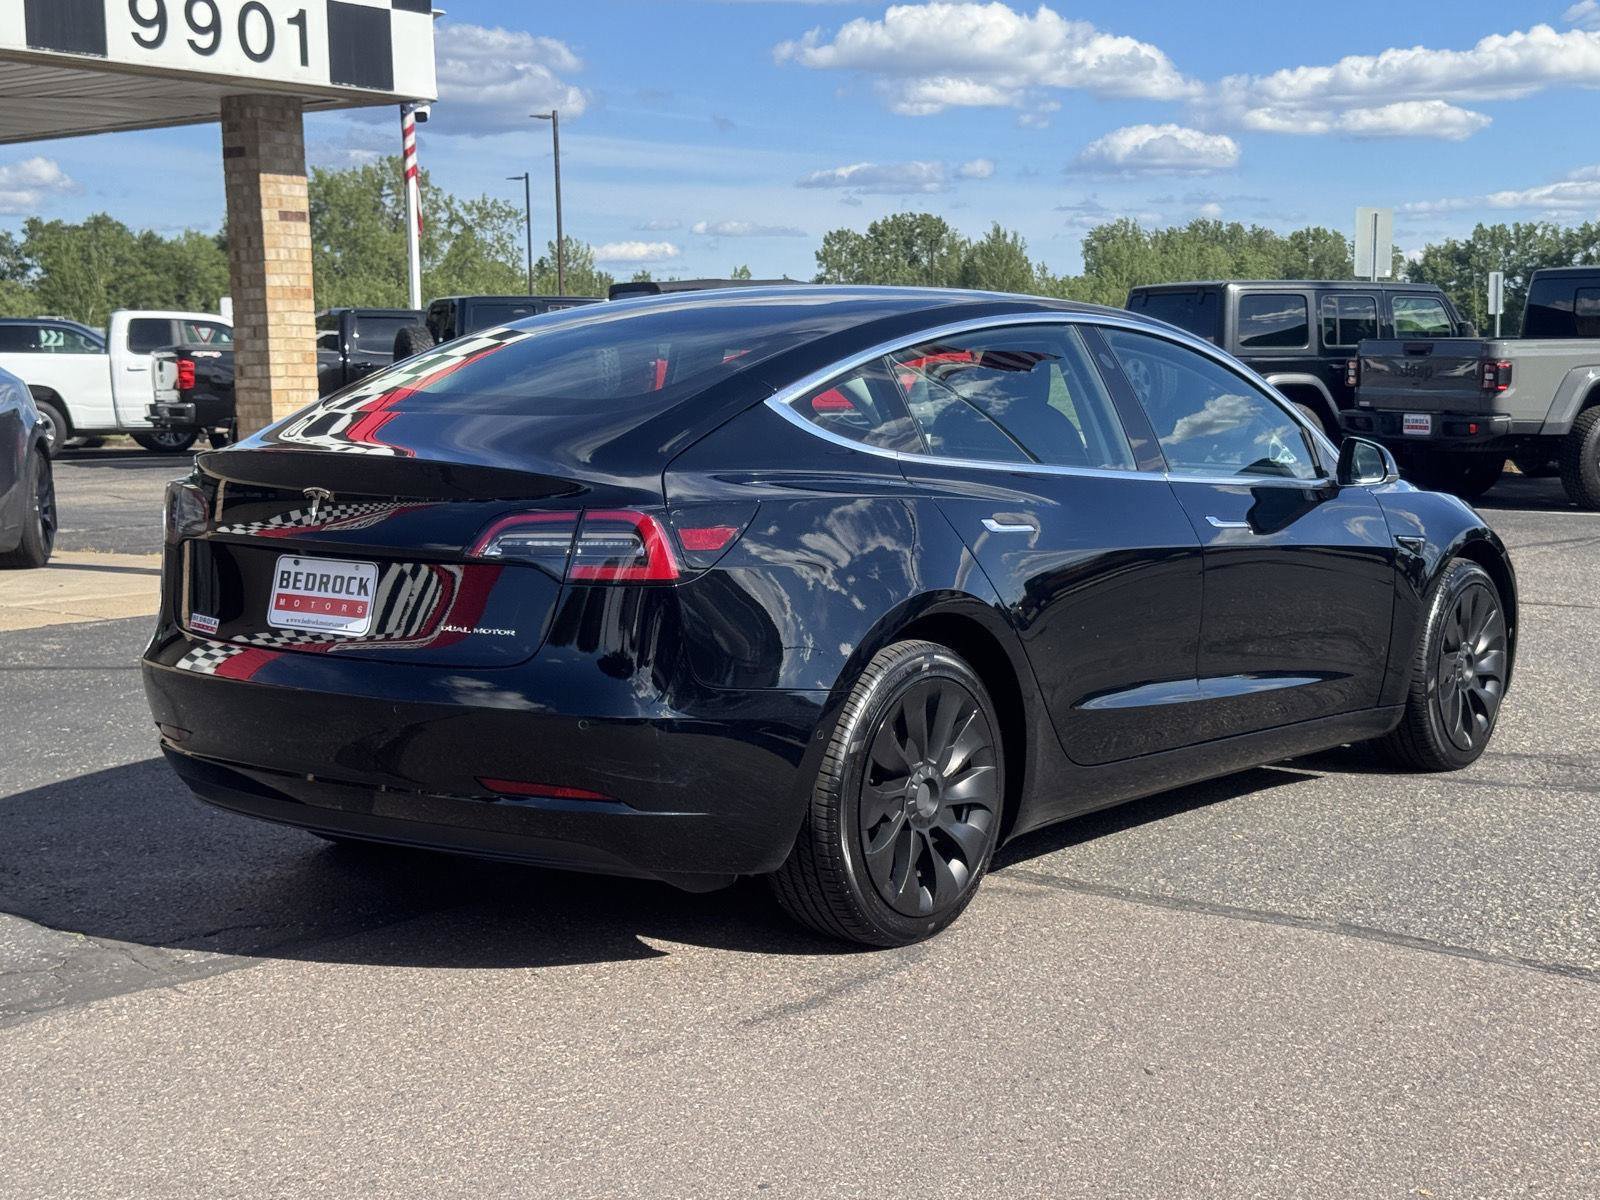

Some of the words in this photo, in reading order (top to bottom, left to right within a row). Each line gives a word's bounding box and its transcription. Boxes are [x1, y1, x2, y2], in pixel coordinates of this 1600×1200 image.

[128, 0, 309, 67] 9901
[278, 570, 371, 597] BEDROCK
[279, 598, 363, 614] MOTORS
[440, 625, 472, 634] DUAL
[473, 627, 516, 637] MOTOR
